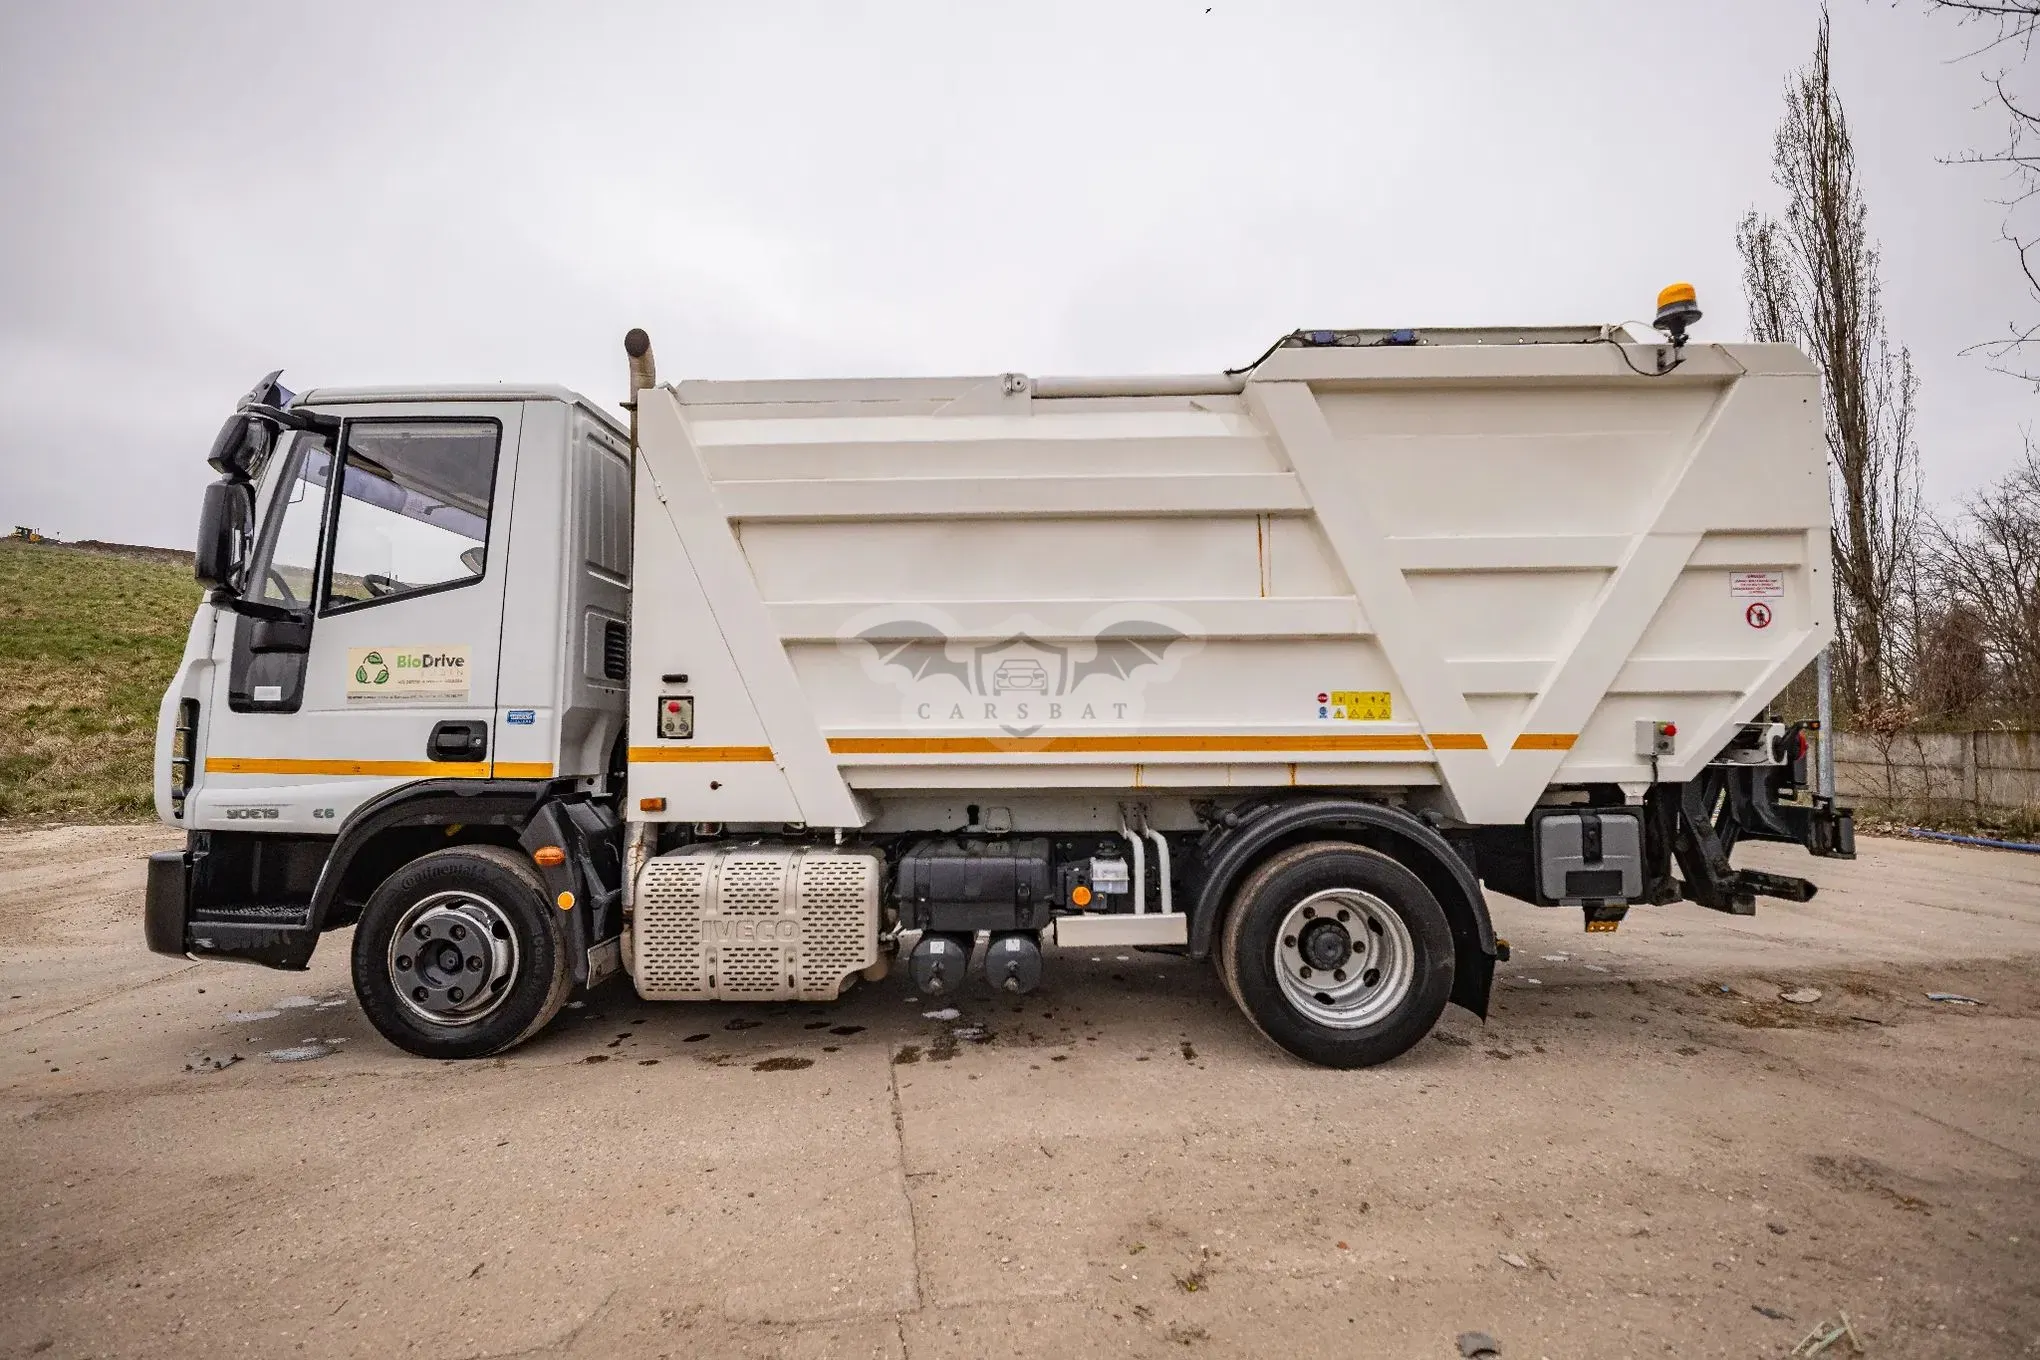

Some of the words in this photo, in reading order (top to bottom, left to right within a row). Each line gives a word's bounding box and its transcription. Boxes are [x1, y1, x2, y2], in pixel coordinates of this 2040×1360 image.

[397, 653, 465, 668] BioDrive
[226, 808, 279, 820] 90E19
[701, 920, 799, 941] IVECO
